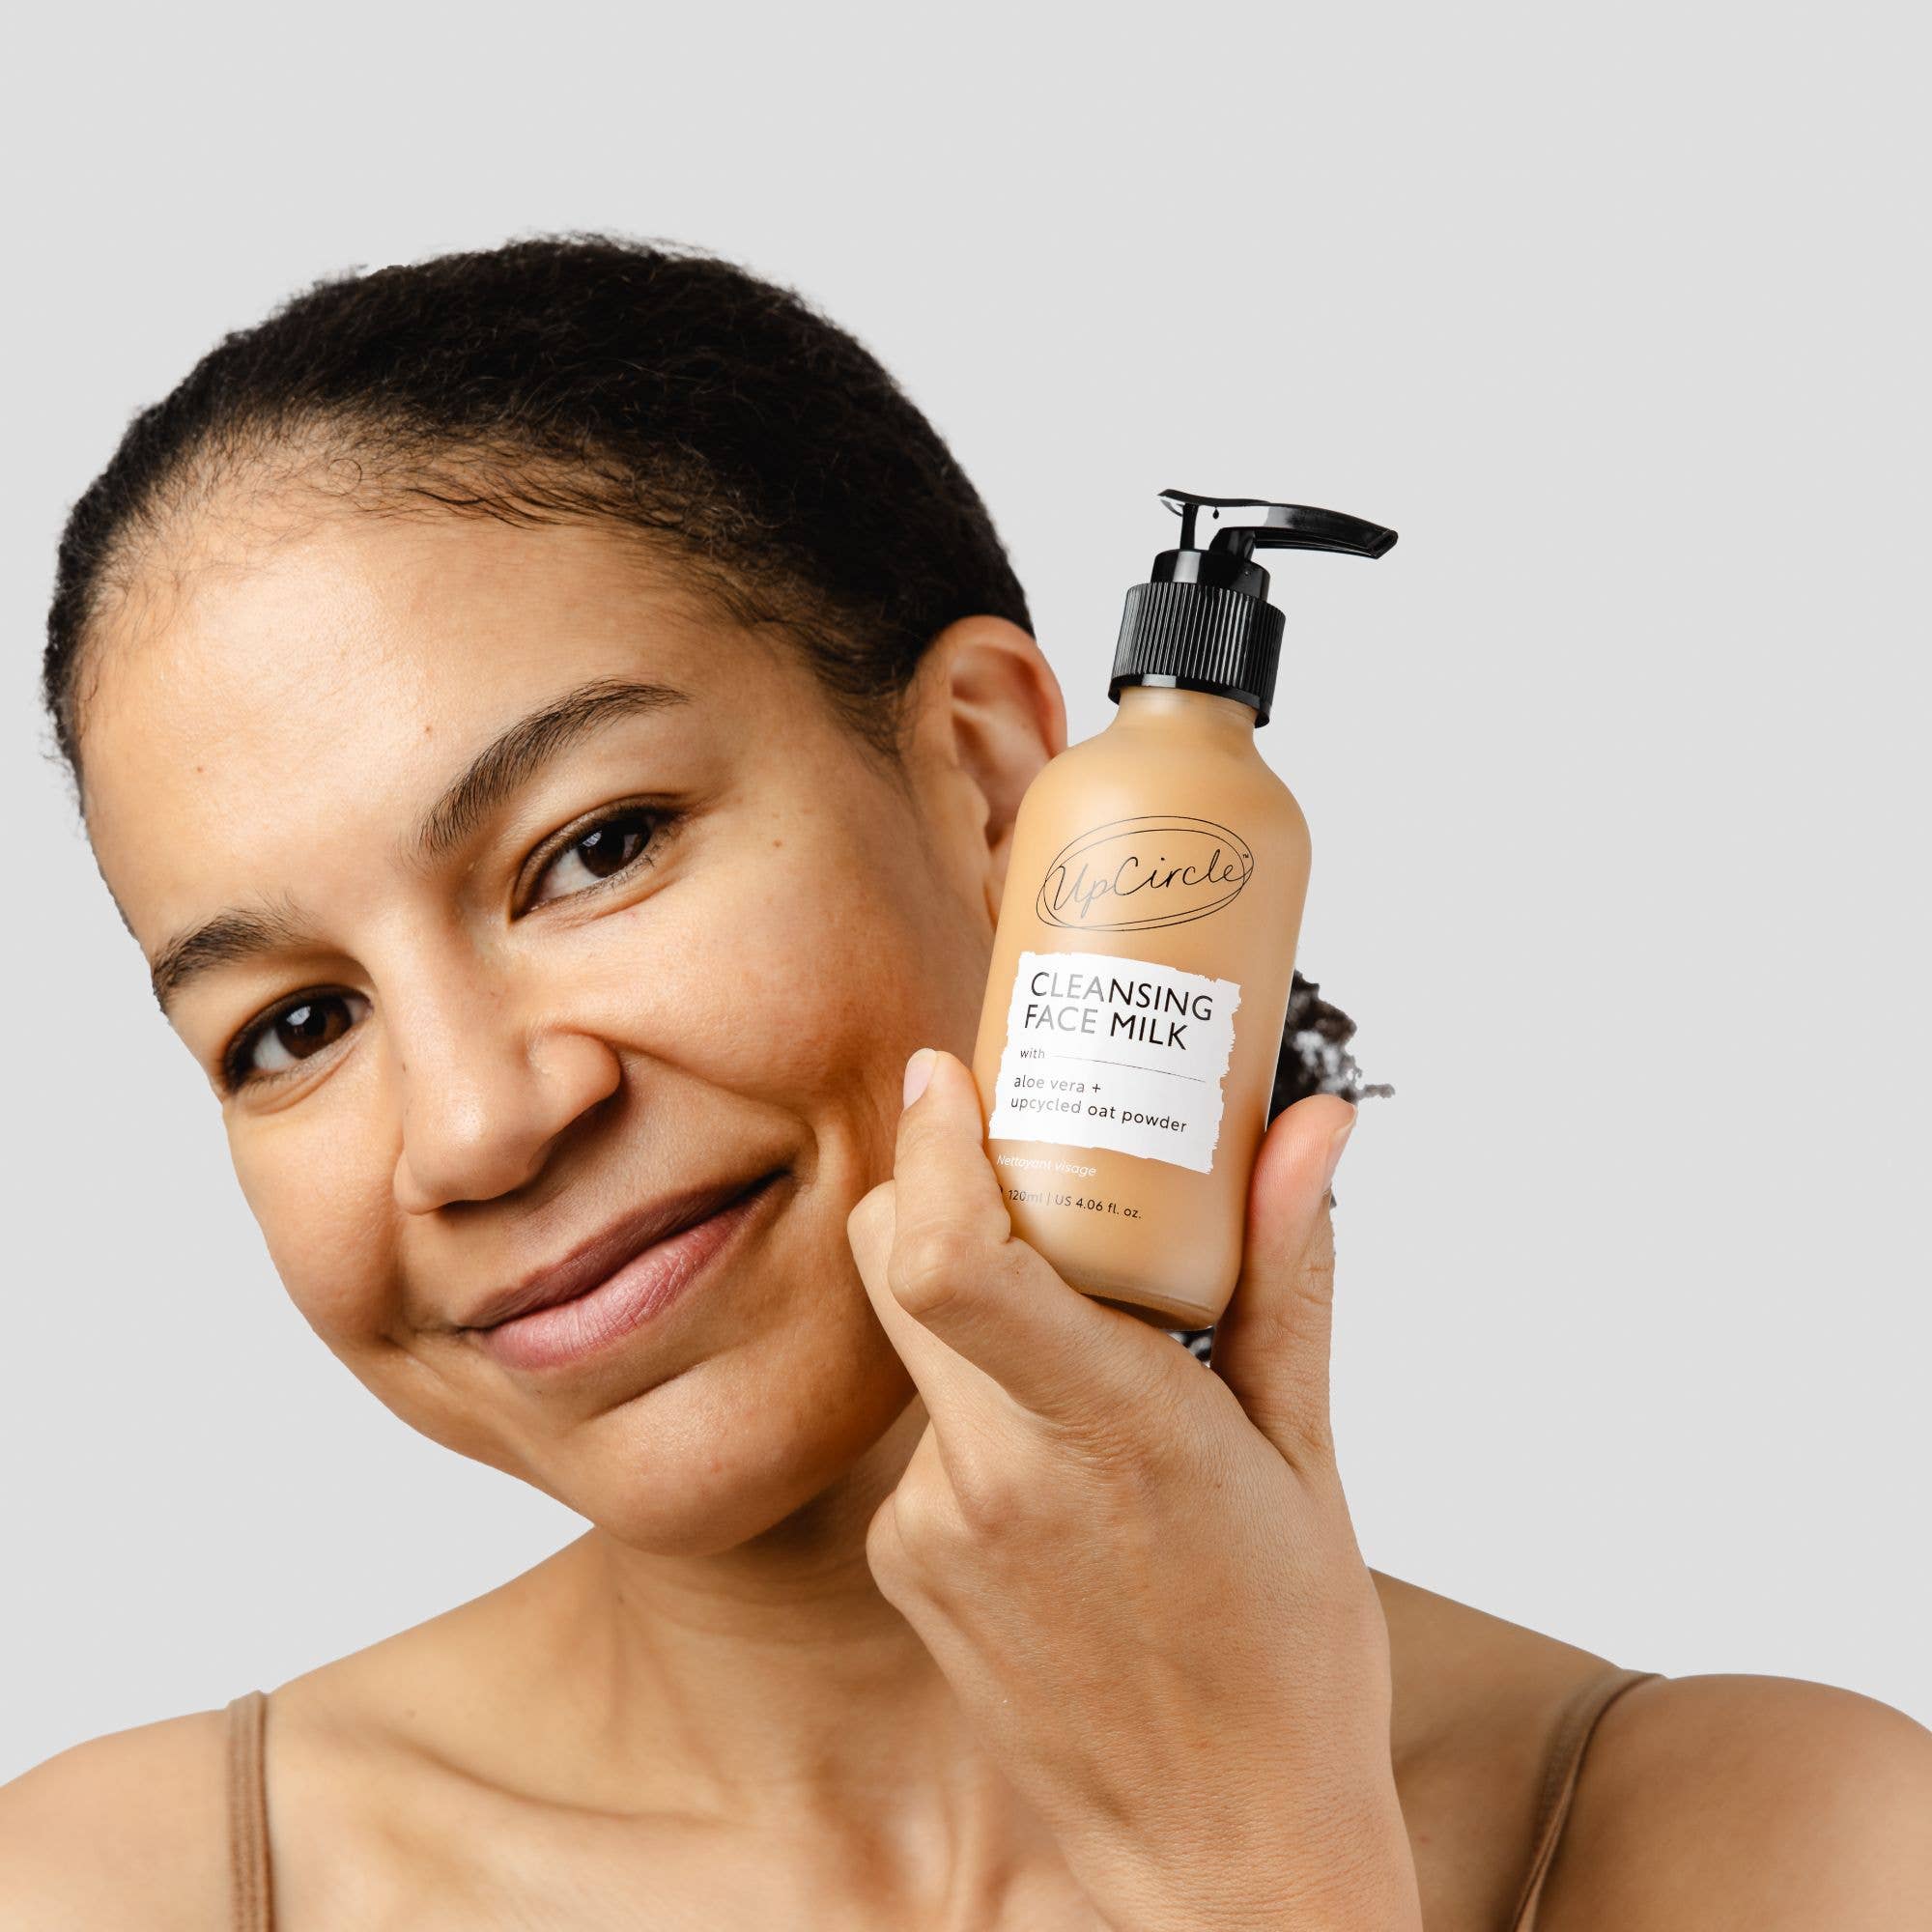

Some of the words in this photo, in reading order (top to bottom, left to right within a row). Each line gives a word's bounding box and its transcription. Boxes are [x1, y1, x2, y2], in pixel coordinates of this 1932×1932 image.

[1031, 971, 1213, 1021] CLEANSING
[1024, 1004, 1098, 1034] FACE
[1110, 1011, 1187, 1050] MILK
[1020, 1047, 1045, 1059] with
[1013, 1074, 1044, 1089] aloe
[1050, 1079, 1085, 1093] vera
[1010, 1097, 1082, 1114] upcycled
[1088, 1105, 1116, 1120] oat
[1122, 1110, 1187, 1133] powder
[997, 1154, 1052, 1170] Nettoyant
[1055, 1160, 1096, 1177] visage
[1009, 1189, 1043, 1204] 120ml
[1055, 1195, 1071, 1207] US
[1075, 1198, 1103, 1211] 4.06
[1107, 1203, 1120, 1215] fl.
[1123, 1208, 1142, 1219] oz.
